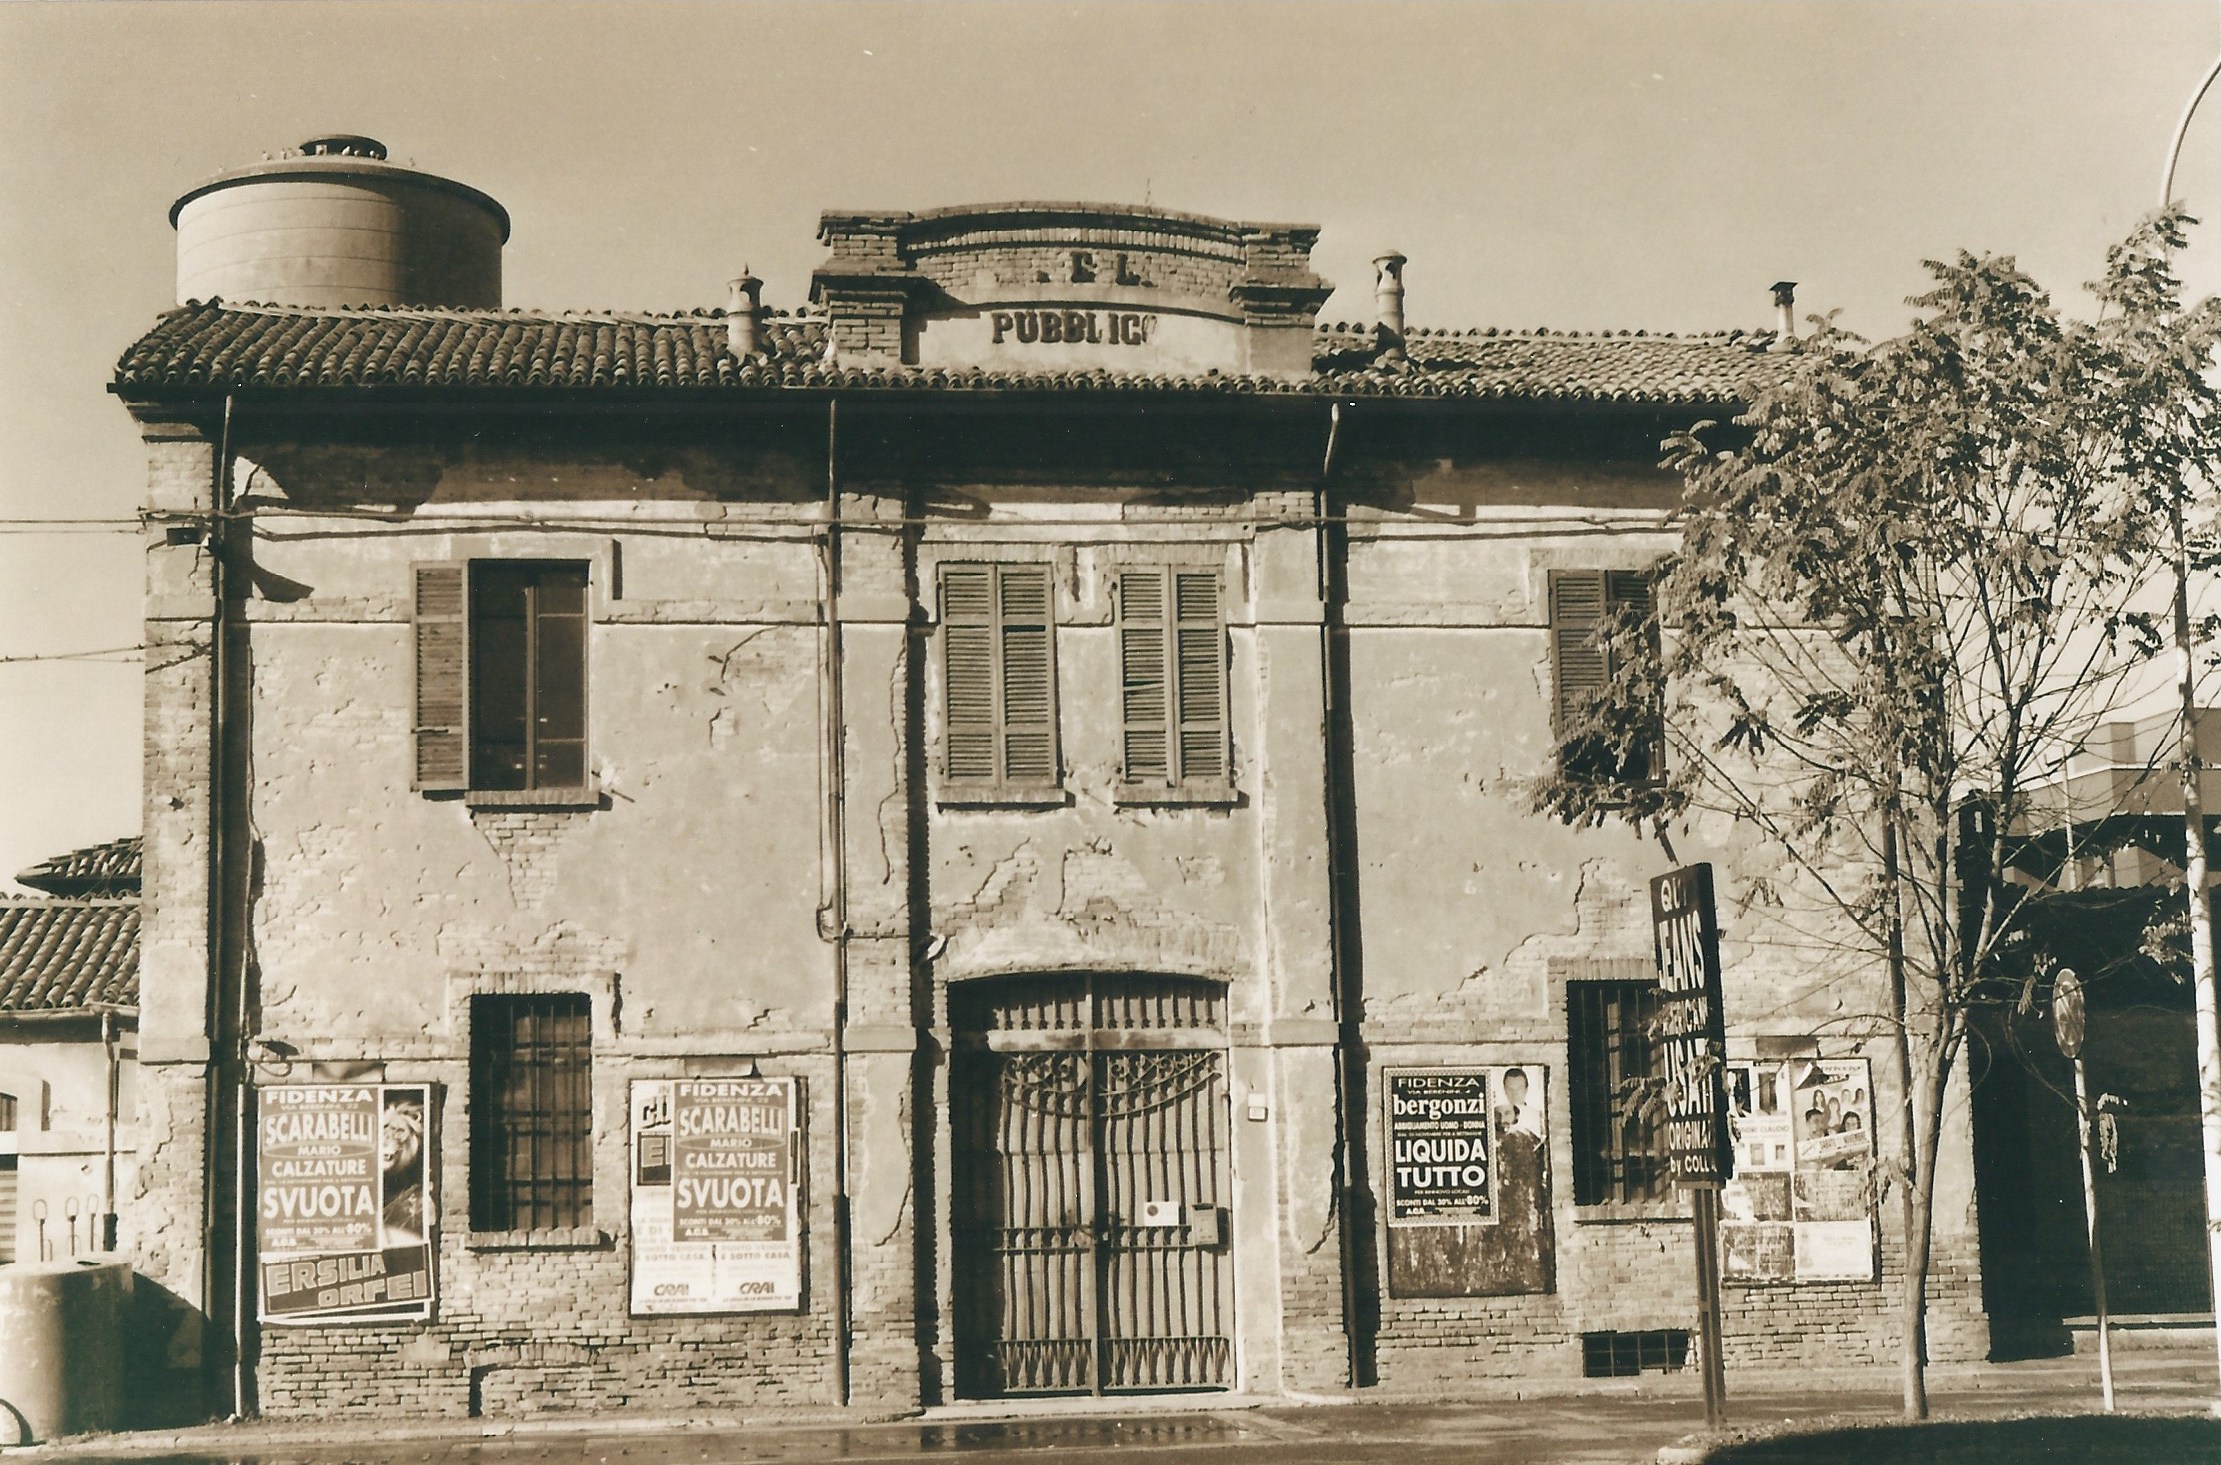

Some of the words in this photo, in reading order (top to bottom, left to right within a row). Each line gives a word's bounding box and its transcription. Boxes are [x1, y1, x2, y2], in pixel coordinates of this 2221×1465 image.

[1658, 910, 1705, 993] JEANS
[681, 1084, 783, 1096] FIDENZA
[1398, 1077, 1479, 1088] FIDENZA
[266, 1090, 373, 1104] FIDENZA
[1393, 1093, 1485, 1120] bergonzi
[265, 1112, 373, 1146] SCARABELLI
[680, 1106, 782, 1137] SCARABELLI
[297, 1145, 341, 1156] MARIO
[710, 1138, 752, 1148] MARIO
[1395, 1139, 1487, 1163] LIQUIDA
[271, 1159, 366, 1177] CALZATURE
[685, 1153, 776, 1169] CALZATURE
[1670, 1156, 1681, 1177] by
[1396, 1165, 1485, 1187] TUTTO
[263, 1185, 375, 1219] SVUOTA
[677, 1177, 784, 1208] SVUOTA
[266, 1254, 386, 1296] ERSILIA
[318, 1270, 428, 1307] ORFEI
[654, 1283, 689, 1296] CRAI
[739, 1282, 775, 1295] CRAI
